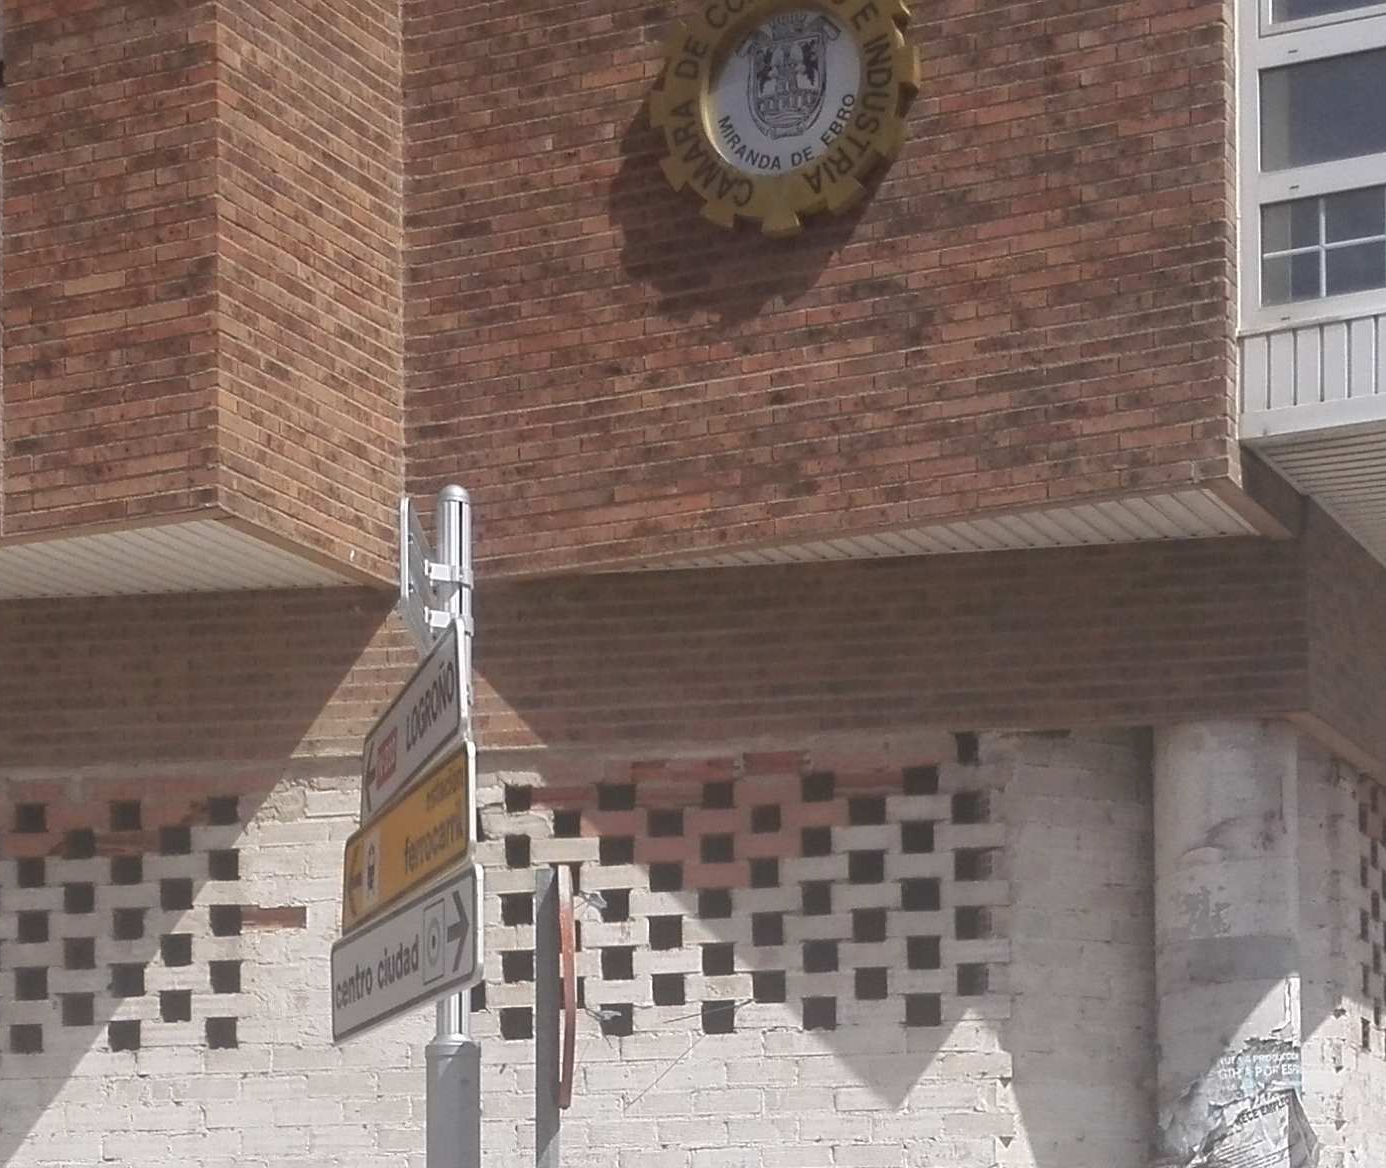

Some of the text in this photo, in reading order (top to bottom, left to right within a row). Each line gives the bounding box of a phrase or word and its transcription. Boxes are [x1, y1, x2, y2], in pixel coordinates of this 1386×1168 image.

[674, 35, 709, 81] DE
[804, 33, 893, 194] INDUSTRIA
[717, 93, 855, 170] MIRANDA DE EBRO
[405, 660, 455, 750] LOGROÑO
[335, 933, 420, 1010] centro ciudad
